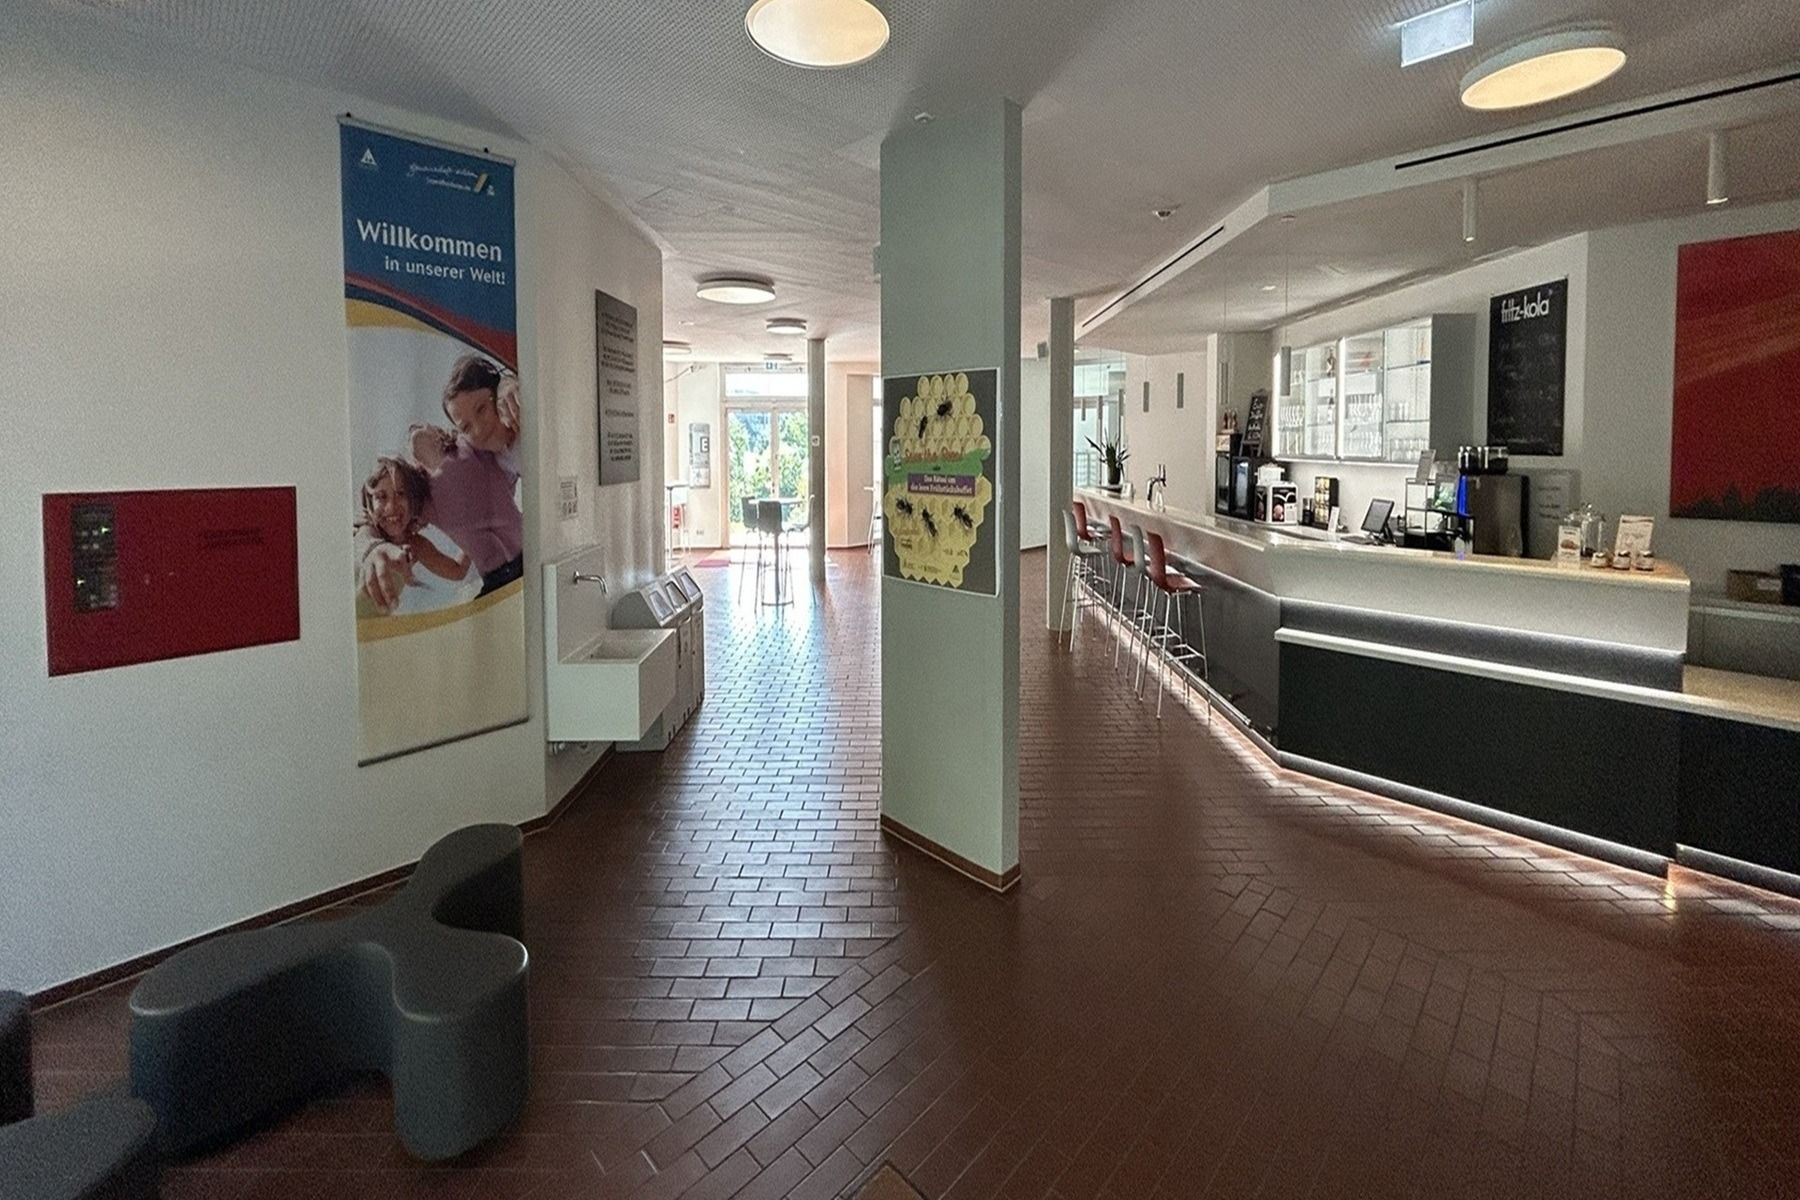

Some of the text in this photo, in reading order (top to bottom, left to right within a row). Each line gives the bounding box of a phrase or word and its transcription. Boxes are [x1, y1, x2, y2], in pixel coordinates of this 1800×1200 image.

[356, 218, 503, 262] Willkommen
[385, 255, 506, 286] in unserer Welt!
[1501, 291, 1550, 324] fritz-kola
